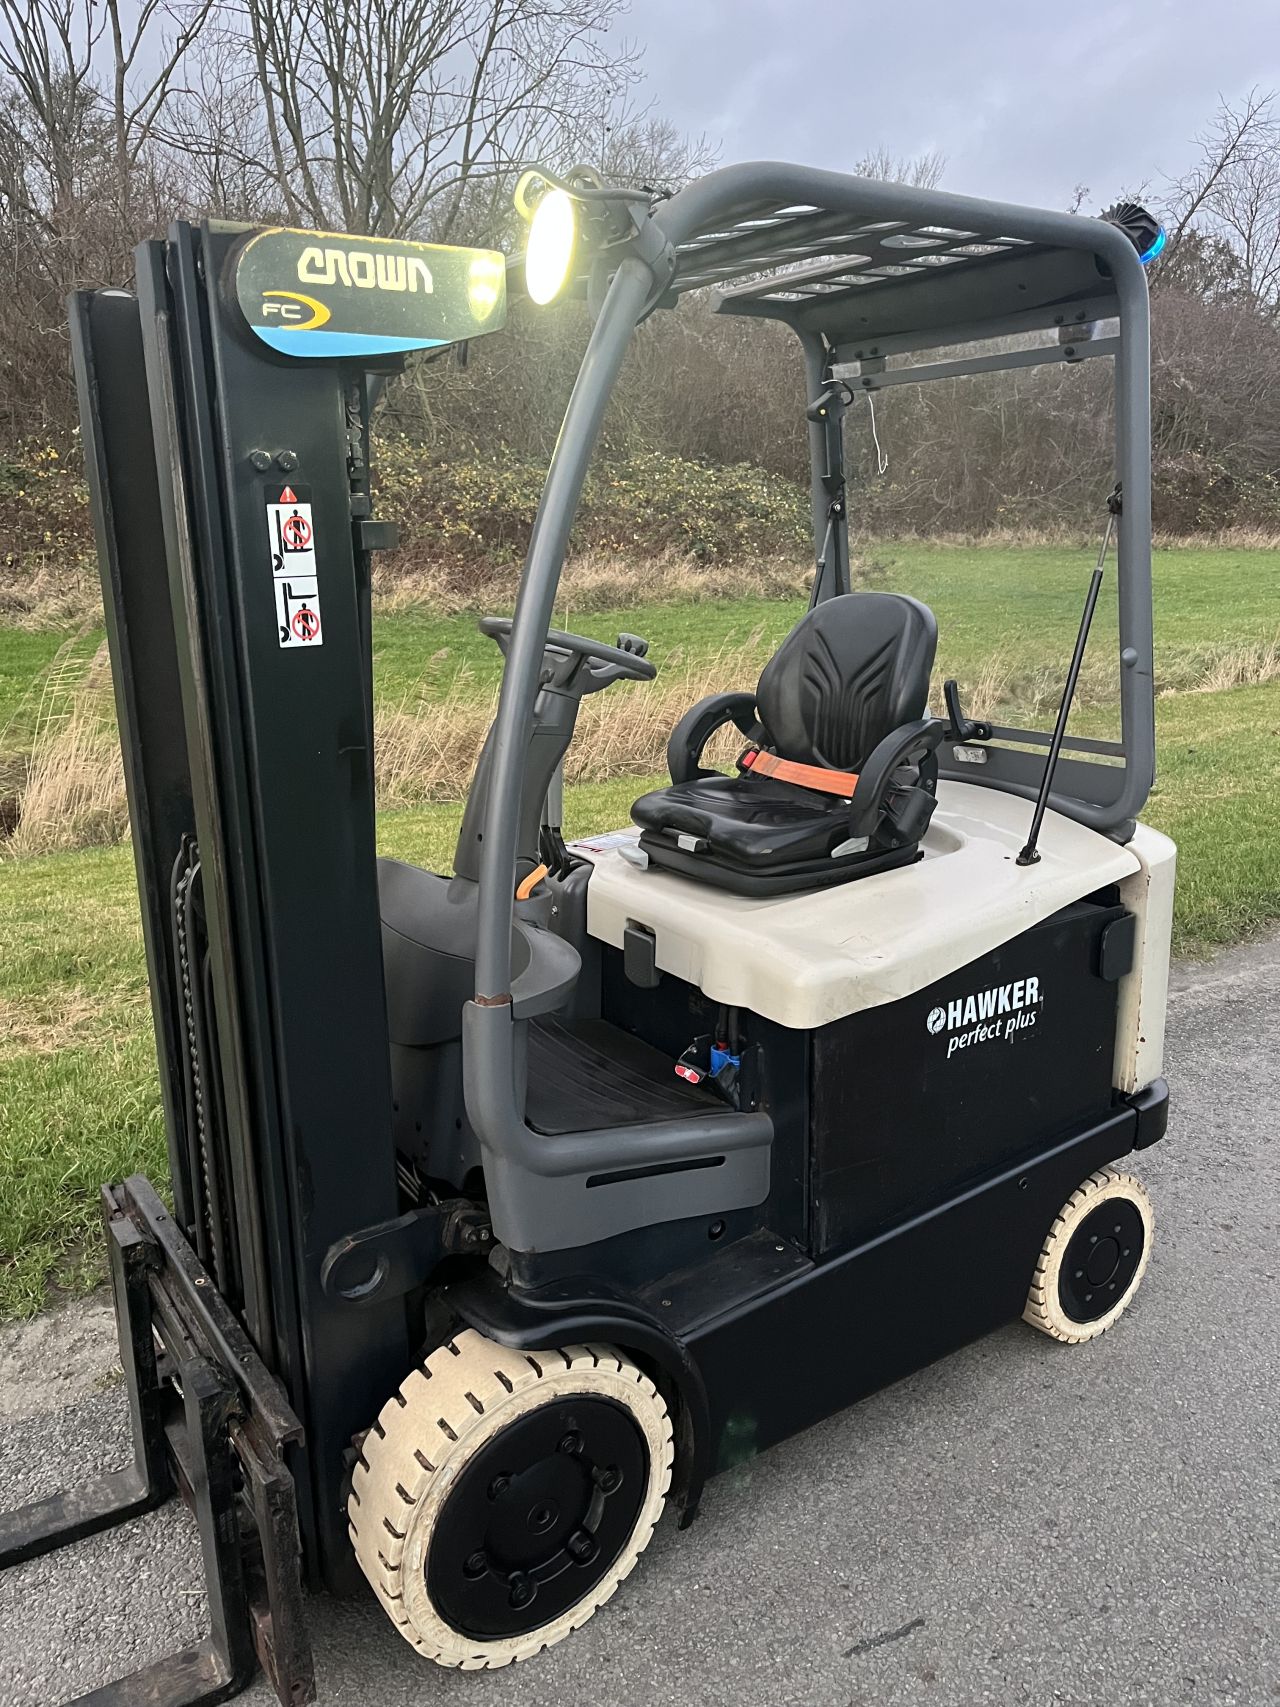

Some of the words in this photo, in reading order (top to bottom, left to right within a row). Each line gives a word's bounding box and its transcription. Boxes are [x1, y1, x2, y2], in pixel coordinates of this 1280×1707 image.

[298, 247, 433, 294] CROWN
[262, 303, 301, 319] FC
[947, 976, 1039, 1031] HAWKER
[947, 1019, 1002, 1059] perfect
[1004, 1010, 1037, 1039] plus
